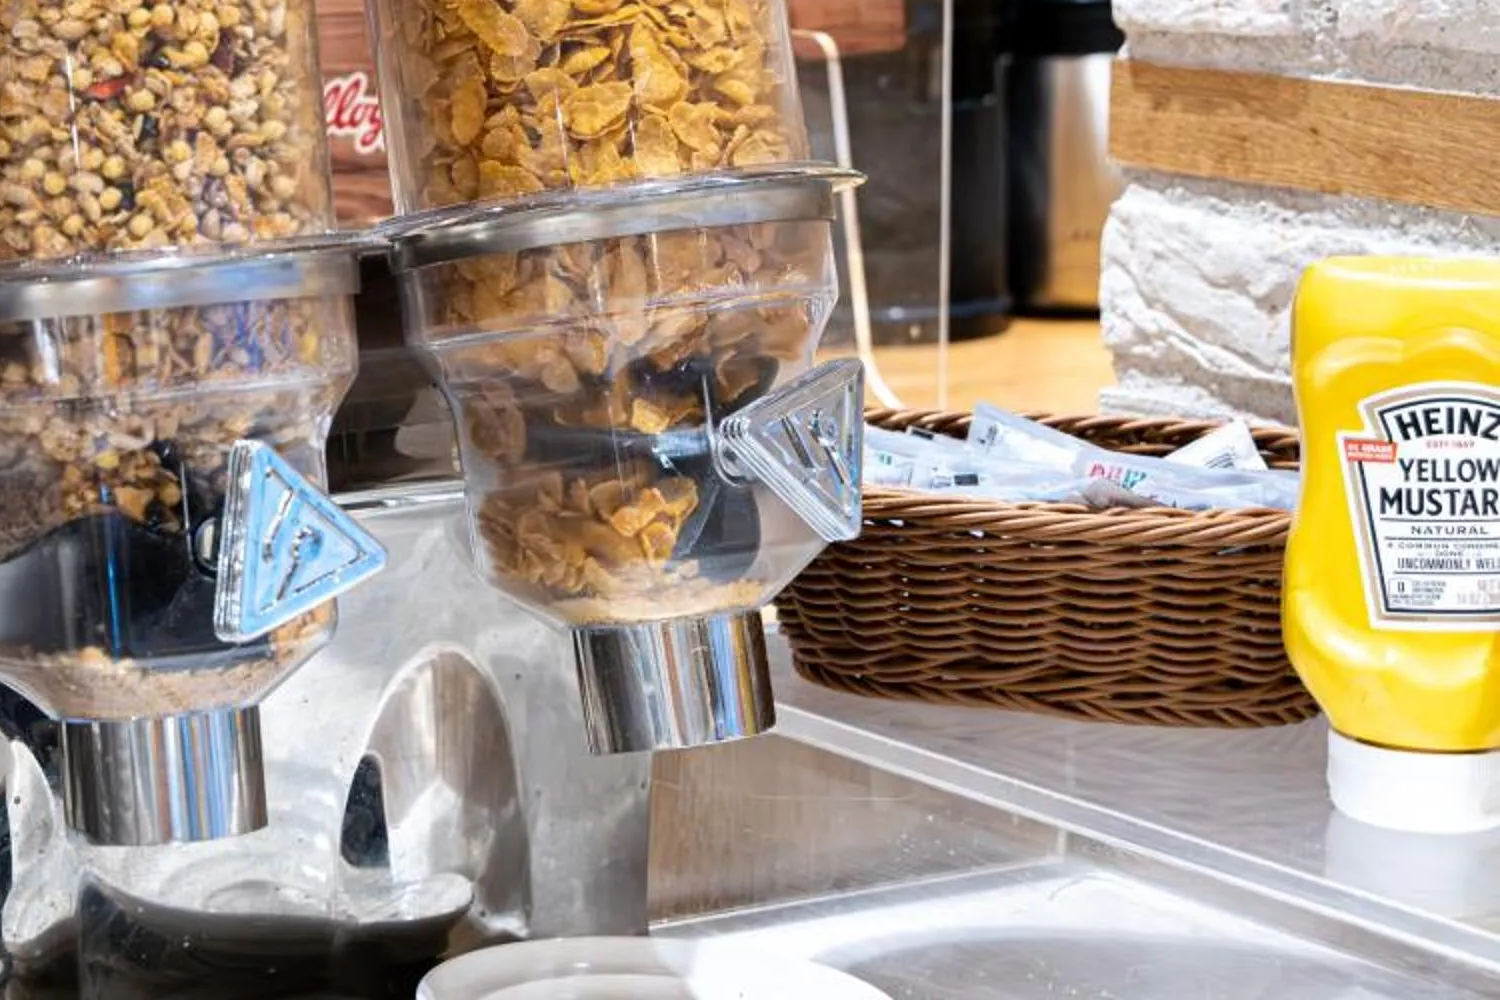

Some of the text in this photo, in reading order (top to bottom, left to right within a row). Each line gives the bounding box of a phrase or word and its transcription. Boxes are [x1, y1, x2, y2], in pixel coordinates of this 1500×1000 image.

[1394, 406, 1500, 441] HEINZ
[1398, 458, 1500, 483] YELLOW
[1411, 525, 1489, 535] NATURAL
